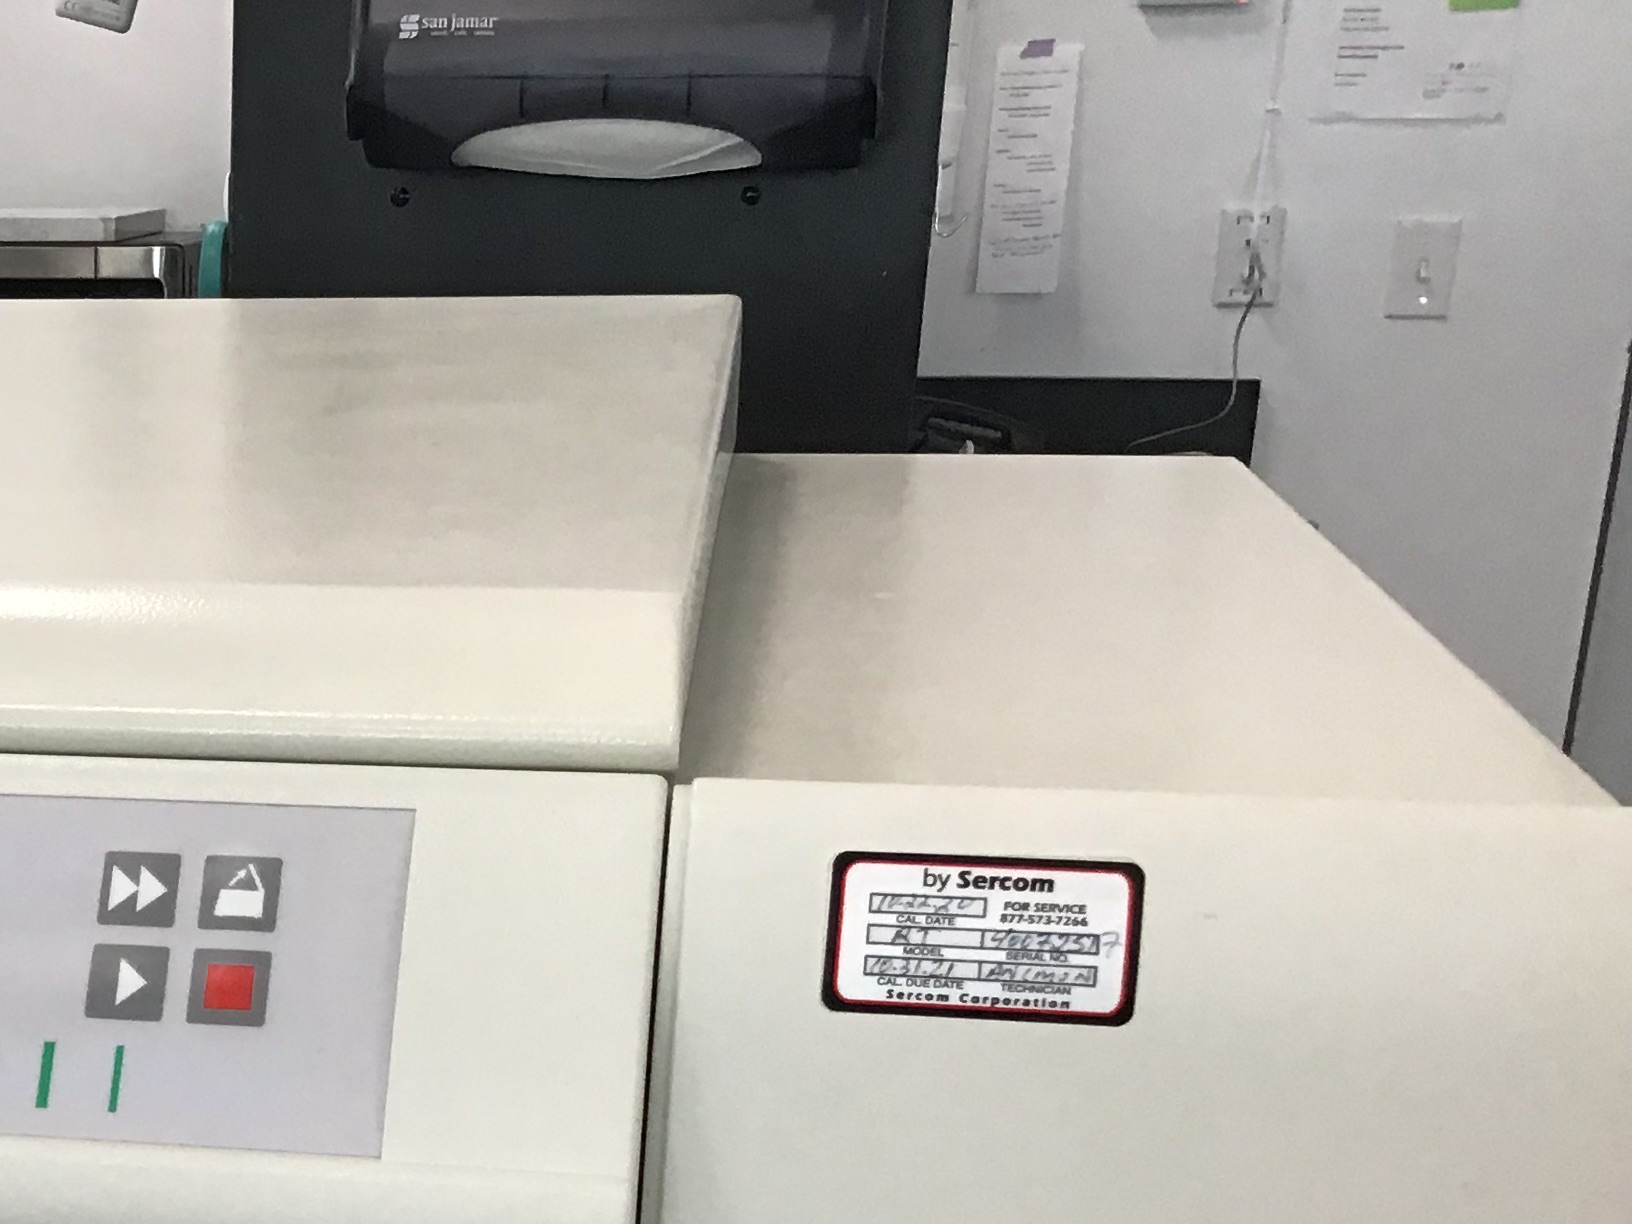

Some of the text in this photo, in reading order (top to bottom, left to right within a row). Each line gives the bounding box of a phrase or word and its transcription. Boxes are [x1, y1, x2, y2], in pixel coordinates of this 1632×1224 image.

[421, 16, 448, 29] san
[923, 868, 1055, 893] by Sercom
[1003, 901, 1088, 914] FOR SERVICE
[925, 915, 956, 926] DATE
[903, 946, 944, 957] MODEL
[1005, 951, 1046, 962] SERIAL
[905, 978, 931, 988] DUE
[933, 980, 965, 990] DATE
[1001, 983, 1072, 996] TECHNICIAN
[886, 989, 1071, 1009] Sercom Corporation
